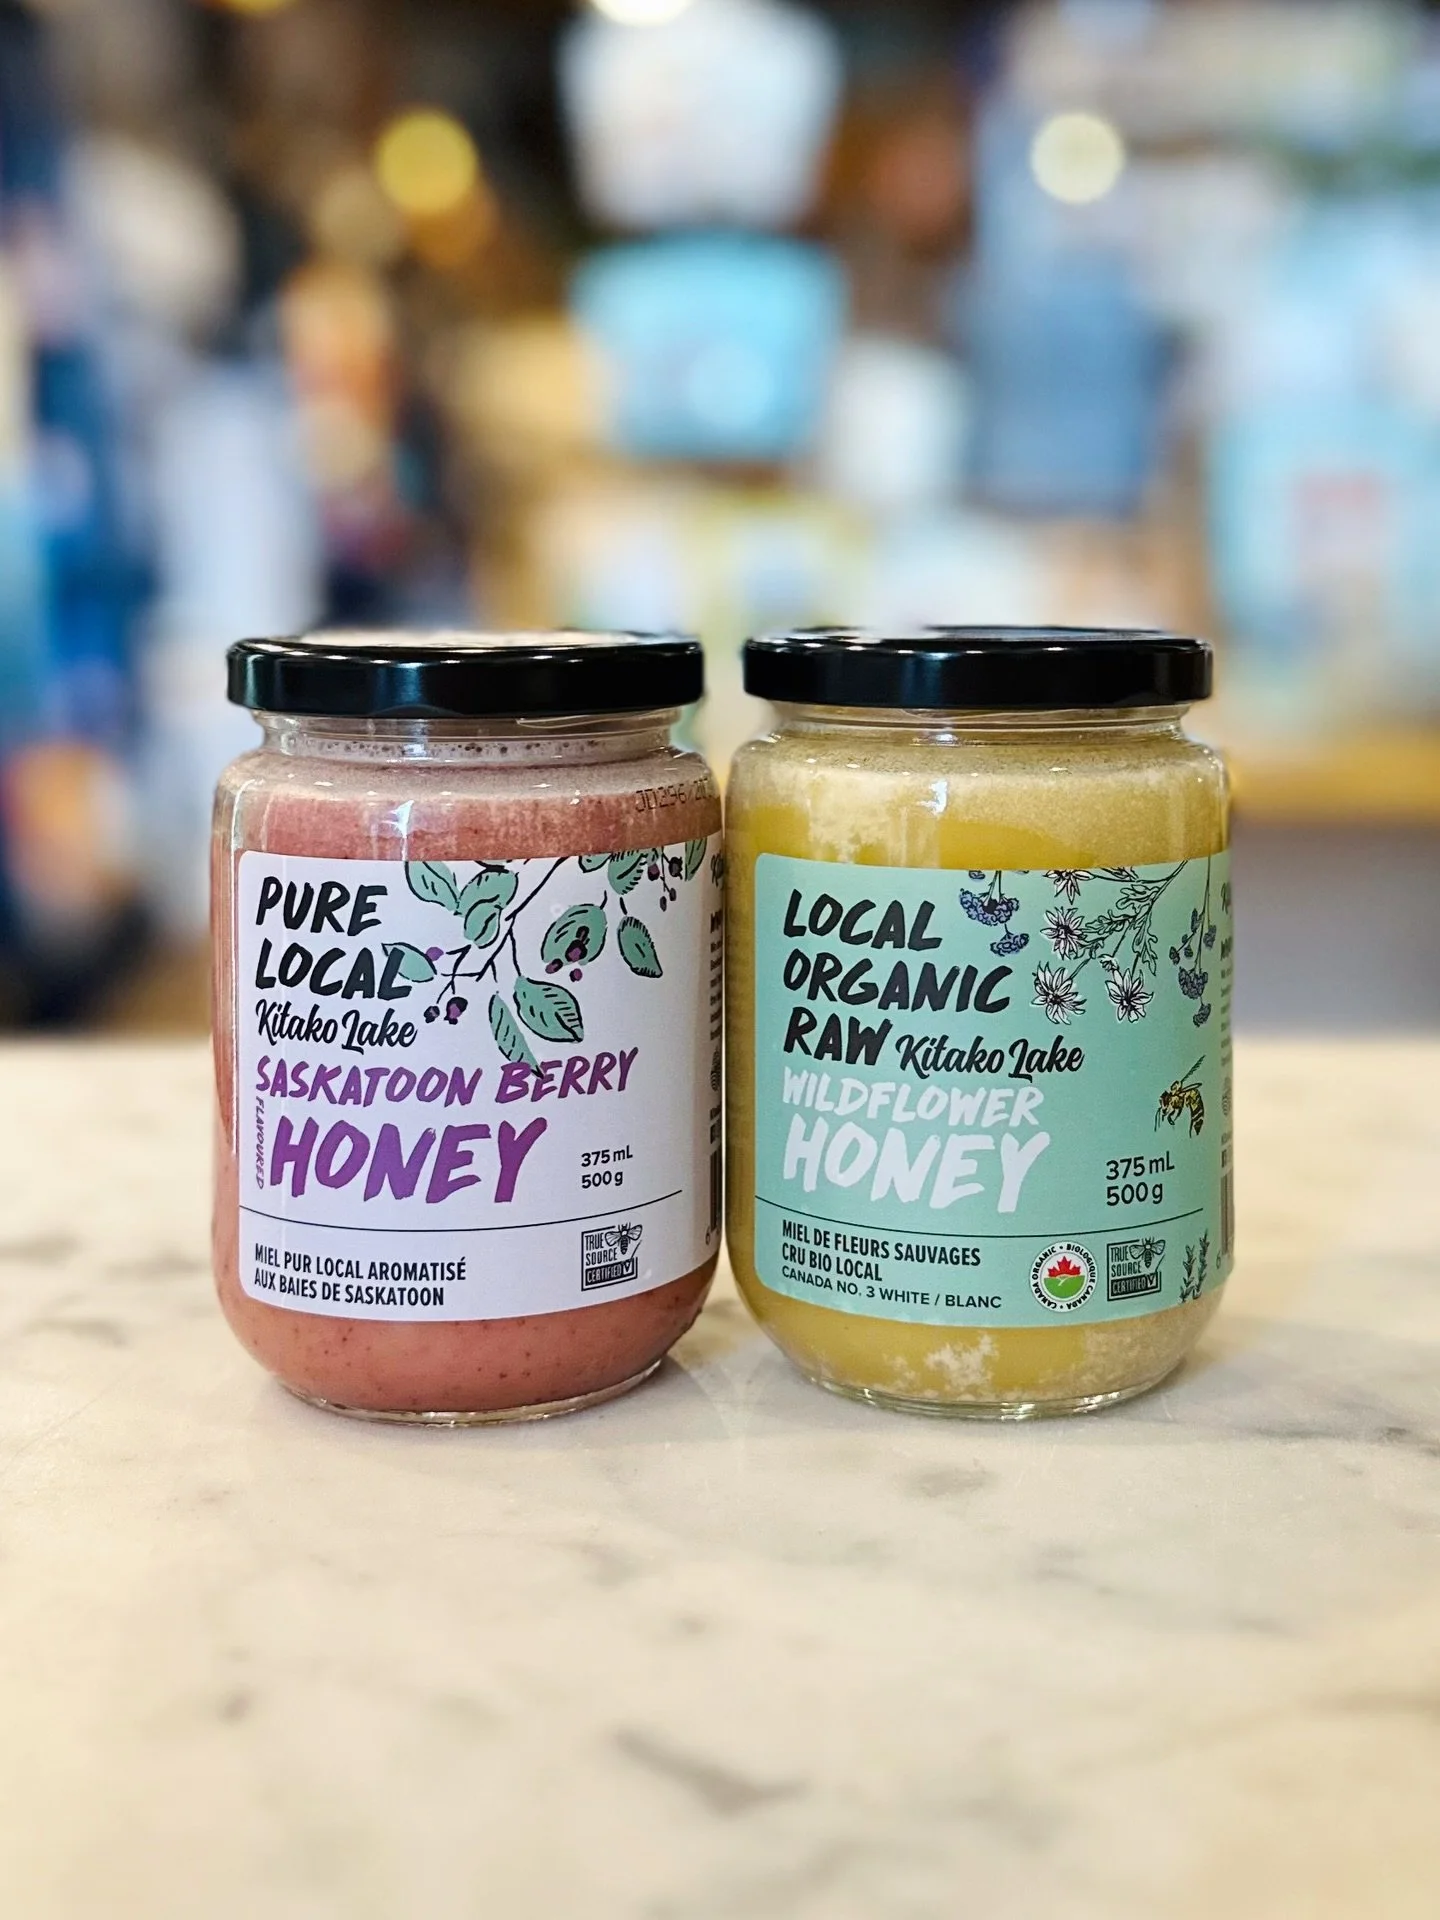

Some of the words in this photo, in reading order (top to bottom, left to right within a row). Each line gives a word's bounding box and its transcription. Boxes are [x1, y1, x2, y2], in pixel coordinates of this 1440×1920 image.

[255, 876, 388, 936] PURE
[783, 888, 942, 951] LOCAL
[255, 938, 412, 1001] LOCAL
[783, 948, 1013, 1014] ORGANIC
[255, 999, 338, 1046] Kitako
[341, 1008, 418, 1055] Lake
[783, 1006, 893, 1066] RAW
[895, 1034, 1004, 1079] Kitako
[1008, 1034, 1085, 1083] Lake
[256, 1055, 483, 1108] SASKATOON
[495, 1047, 639, 1106] BERRY
[782, 1065, 1044, 1128] WILDFLOWER
[255, 1096, 265, 1190] FLAVOURED
[270, 1115, 548, 1204] HONEY
[783, 1113, 1050, 1213] HONEY
[255, 1243, 280, 1268] MIEL
[284, 1251, 312, 1273] PUR
[316, 1256, 363, 1279] LOCAL
[367, 1256, 466, 1281] AROMATISÉ
[585, 1232, 604, 1251] TRUE
[585, 1247, 617, 1266] SOURCE
[782, 1219, 810, 1244] MIEL
[813, 1228, 830, 1248] DE
[835, 1233, 889, 1259] FLEURS
[894, 1243, 980, 1266] SAUVAGES
[782, 1243, 805, 1265] CRU
[809, 1251, 831, 1272] BIO
[836, 1257, 882, 1281] LOCAL
[1031, 1246, 1057, 1280] ORGANIC
[1110, 1245, 1129, 1262] TRUE
[587, 1264, 622, 1283] CERTIFIED
[1066, 1243, 1096, 1284] BIOLOGIQUE
[1111, 1260, 1141, 1277] SOURCE
[254, 1267, 276, 1290] AUX
[279, 1274, 317, 1299] BAIES
[321, 1281, 340, 1301] DE
[344, 1284, 444, 1306] SASKATOON
[782, 1265, 833, 1290] CANADA
[837, 1281, 861, 1296] NO.
[866, 1286, 875, 1298] 3
[879, 1287, 930, 1305] WHITE
[945, 1294, 1002, 1308] BLANC
[1032, 1281, 1057, 1309] CANADA
[1066, 1285, 1093, 1309] CANADA
